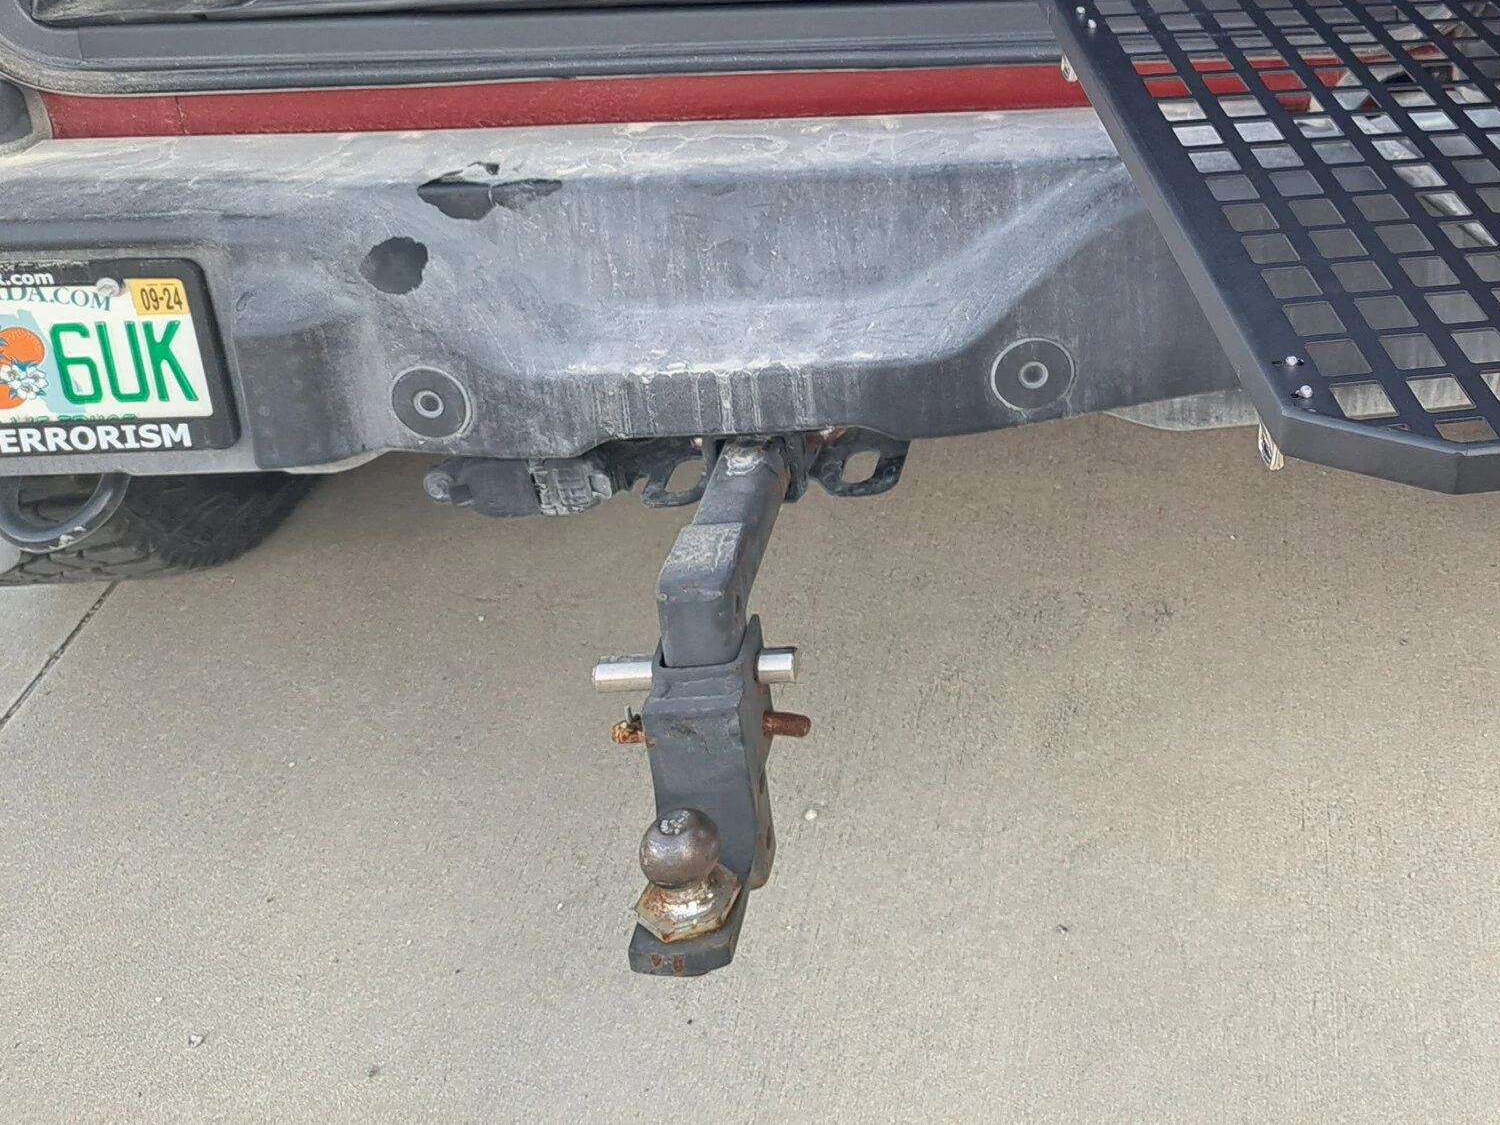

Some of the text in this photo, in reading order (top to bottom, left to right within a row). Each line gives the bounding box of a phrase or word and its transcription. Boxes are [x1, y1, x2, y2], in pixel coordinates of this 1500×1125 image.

[0, 273, 55, 286] .com
[0, 285, 111, 311] DA.COM
[140, 286, 183, 311] 09-24
[50, 320, 199, 404] 6UK
